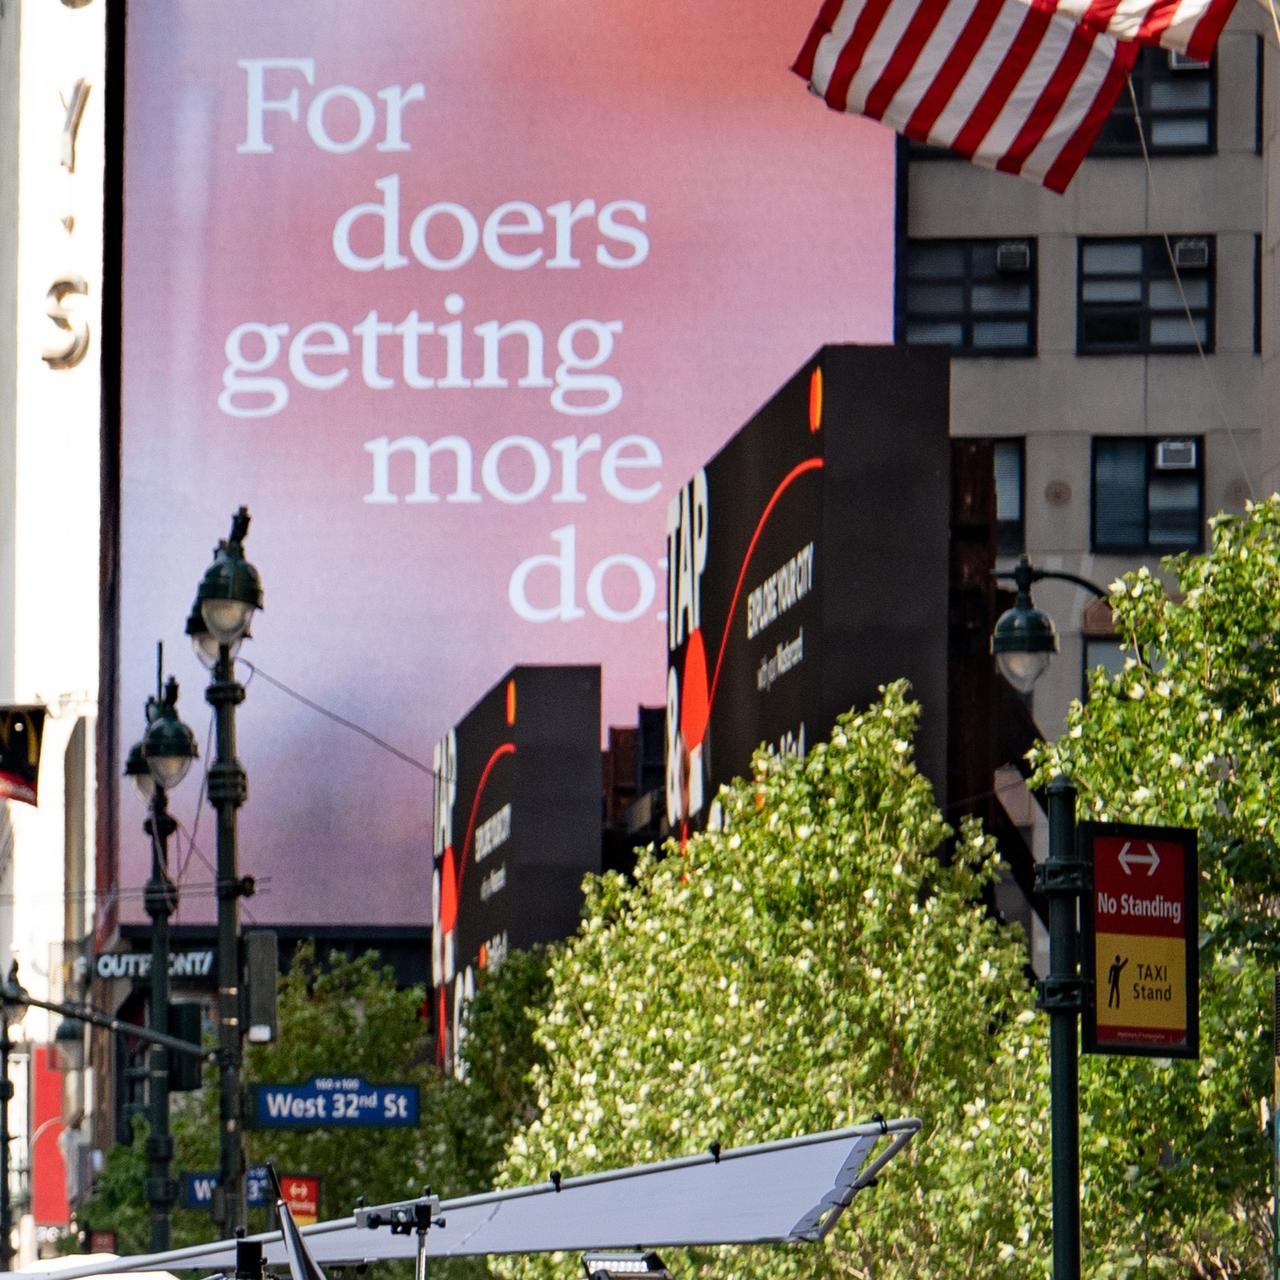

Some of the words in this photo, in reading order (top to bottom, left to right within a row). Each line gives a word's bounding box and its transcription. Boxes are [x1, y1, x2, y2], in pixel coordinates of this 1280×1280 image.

[238, 57, 425, 154] For
[42, 0, 93, 370] Y'S
[332, 174, 649, 271] doers
[217, 293, 623, 419] getting
[363, 432, 664, 505] more
[507, 525, 669, 623] do
[666, 467, 709, 651] TAP
[1097, 892, 1117, 915] No
[1120, 893, 1182, 924] Standing
[1132, 982, 1172, 1002] Stand
[1136, 963, 1168, 983] TAXI
[266, 1092, 327, 1119] West
[331, 1090, 378, 1119] 32nd
[383, 1092, 409, 1119] St
